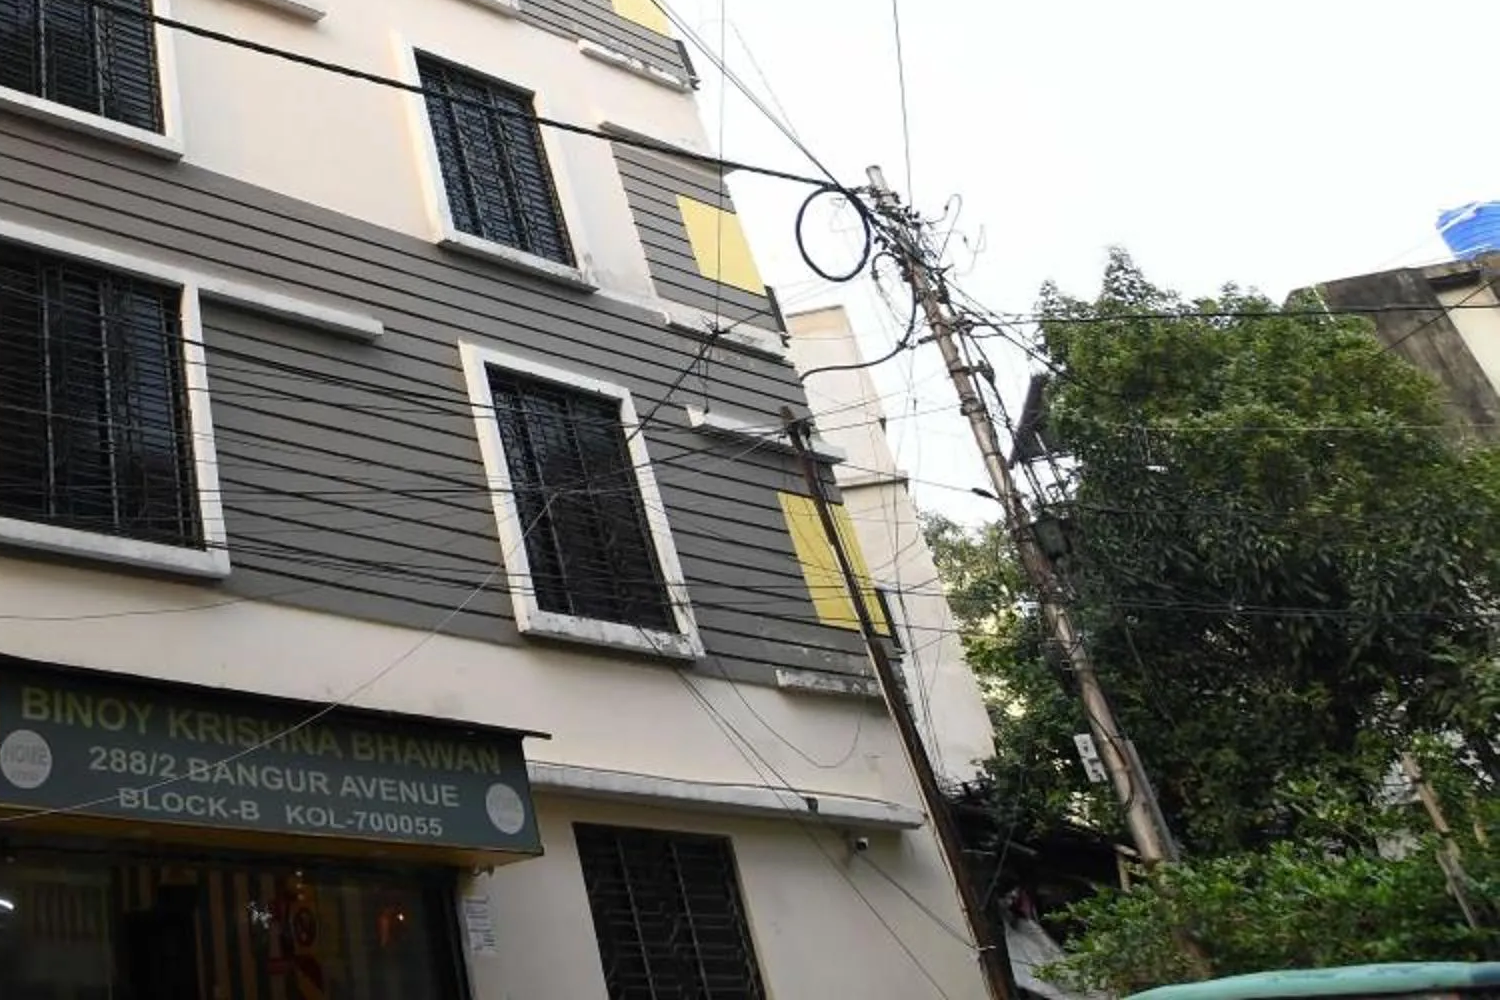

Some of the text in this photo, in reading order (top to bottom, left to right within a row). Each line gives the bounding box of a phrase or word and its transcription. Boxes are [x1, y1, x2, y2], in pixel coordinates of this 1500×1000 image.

[21, 687, 501, 775] BINOY KRISHNA BHAWAN
[88, 746, 460, 808] 288/2 BANGUR AVENUE
[118, 787, 443, 837] BLOCK-B KOL-700055
